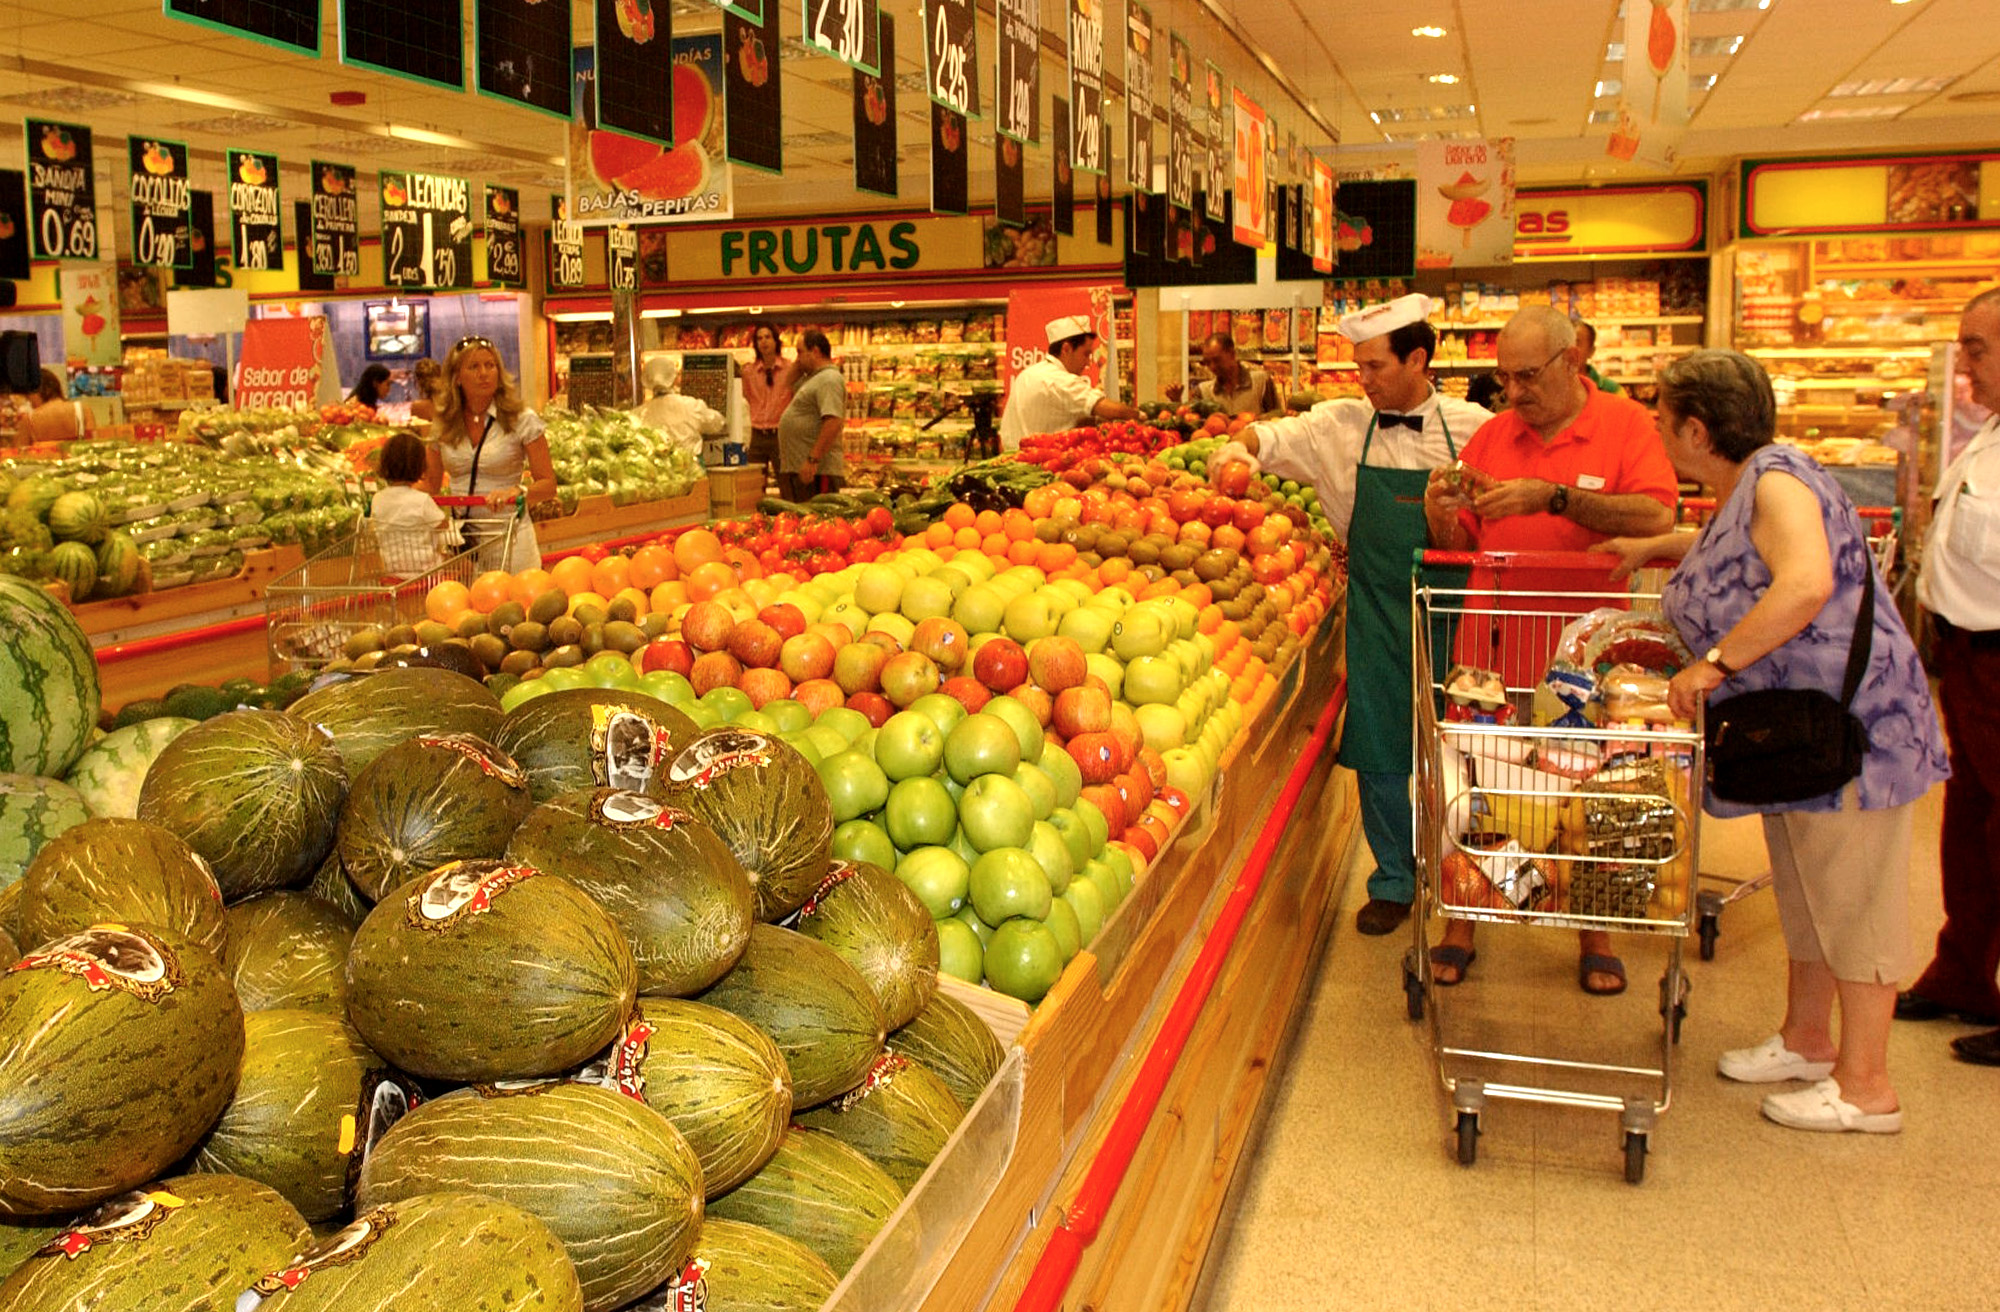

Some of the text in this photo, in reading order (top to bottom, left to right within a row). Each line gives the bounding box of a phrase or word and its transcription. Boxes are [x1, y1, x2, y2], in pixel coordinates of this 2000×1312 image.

[579, 189, 640, 213] BAJAS
[641, 193, 720, 217] PEPITAS
[721, 222, 920, 276] FRUTAS
[243, 365, 308, 387] Sabor de
